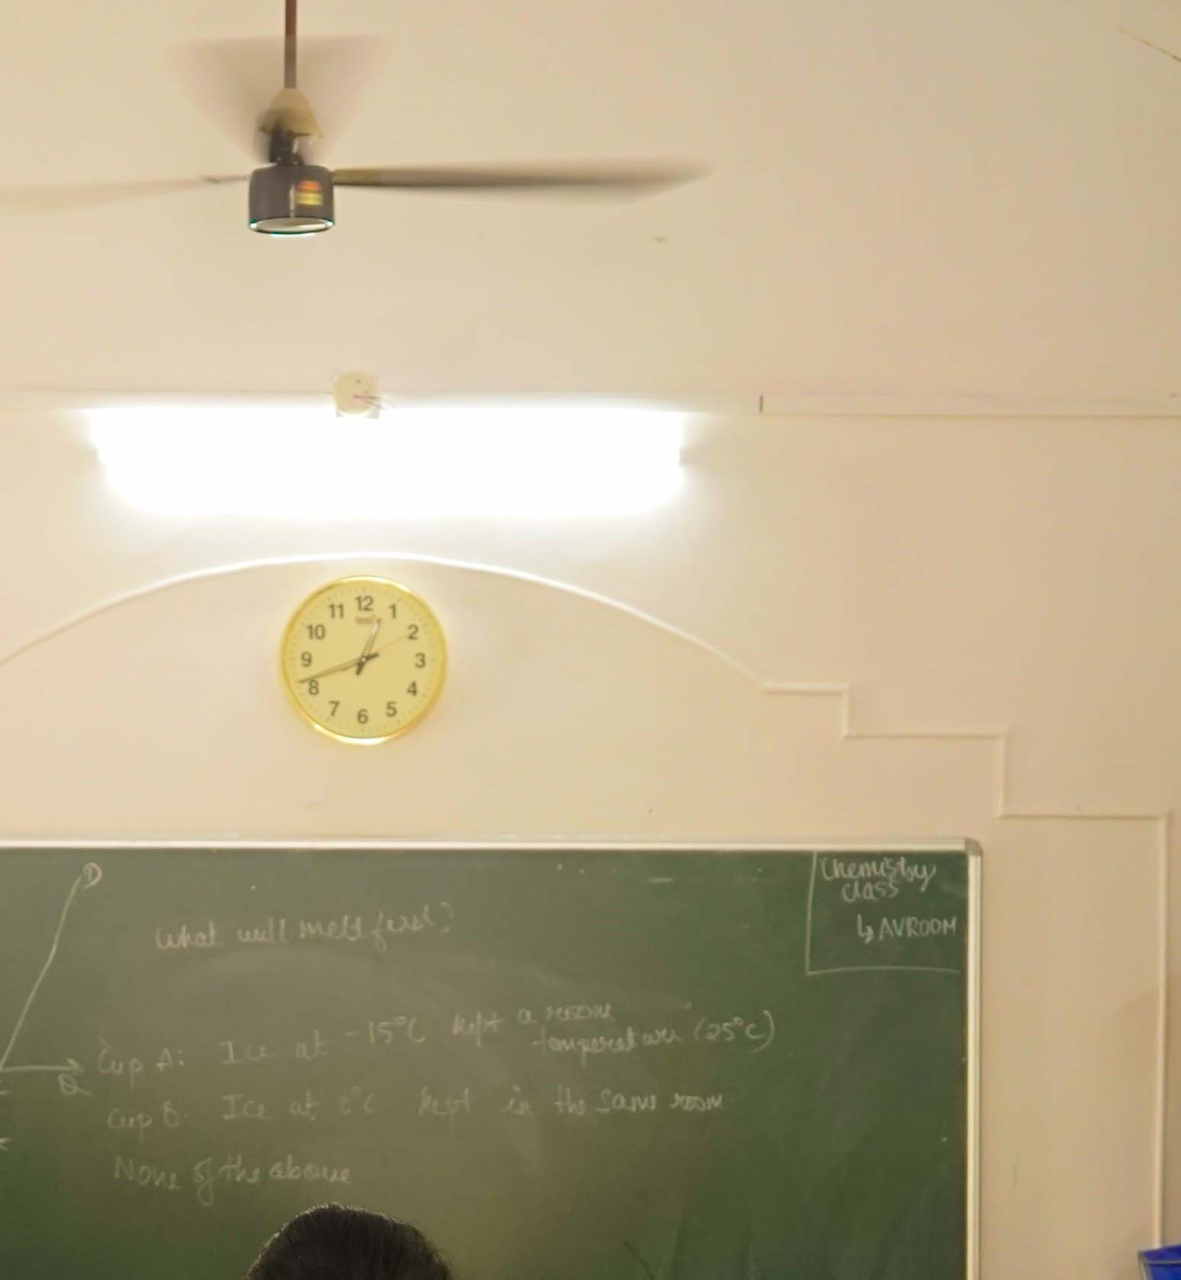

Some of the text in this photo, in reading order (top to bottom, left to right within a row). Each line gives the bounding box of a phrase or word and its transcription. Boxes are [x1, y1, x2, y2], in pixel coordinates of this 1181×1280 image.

[328, 603, 345, 619] 11
[354, 595, 374, 612] 12
[389, 603, 398, 619] 1
[306, 624, 326, 640] 10
[408, 624, 419, 640] 2
[301, 651, 312, 667] 9
[415, 652, 426, 668] 3
[308, 679, 320, 696] 8
[406, 681, 418, 697] 4
[329, 700, 340, 717] 7
[386, 701, 398, 717] 5
[357, 709, 369, 725] 6
